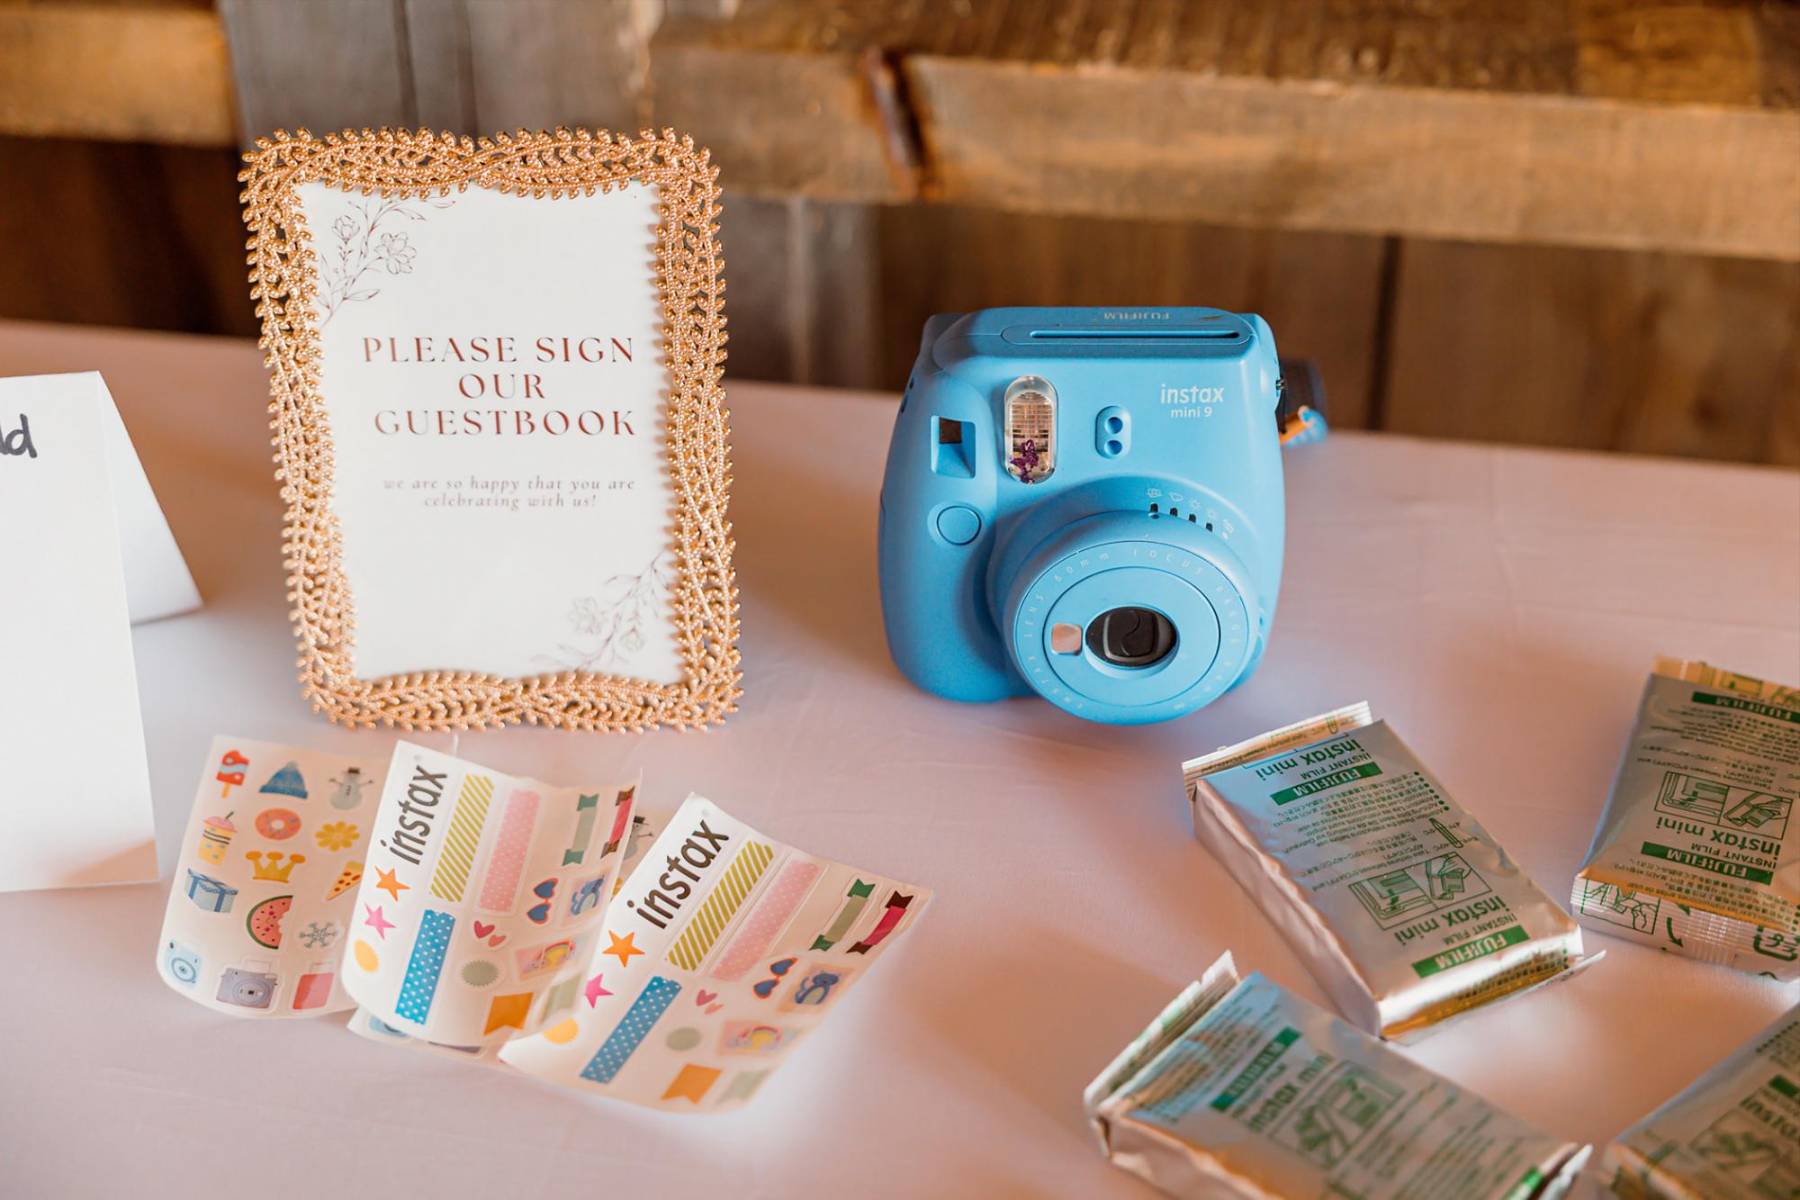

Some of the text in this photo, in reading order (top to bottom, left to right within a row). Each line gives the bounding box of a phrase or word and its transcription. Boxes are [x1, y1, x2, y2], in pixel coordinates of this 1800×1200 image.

[363, 336, 633, 363] PLEASE SIGN
[458, 373, 545, 399] OUR
[1160, 383, 1225, 404] instax
[374, 410, 636, 436] GUESTBOOK
[1170, 406, 1213, 418] mini 9
[383, 475, 636, 495] we are so happy that you are
[424, 492, 597, 512] celebrating with us!
[1300, 739, 1363, 765] instax
[1256, 757, 1299, 781] mini
[1301, 752, 1370, 781] INSTANT FILM
[1293, 767, 1361, 797] FUJIFILM
[380, 764, 448, 866] instax
[1655, 816, 1781, 859] instax mini
[1665, 848, 1747, 876] FUJIFILM
[1690, 842, 1776, 868] INSTANT FILM
[627, 818, 730, 931] instax
[1395, 896, 1509, 946] instax mini
[1443, 913, 1517, 944] INSTANT FILM
[1434, 935, 1507, 968] FUJIFILM
